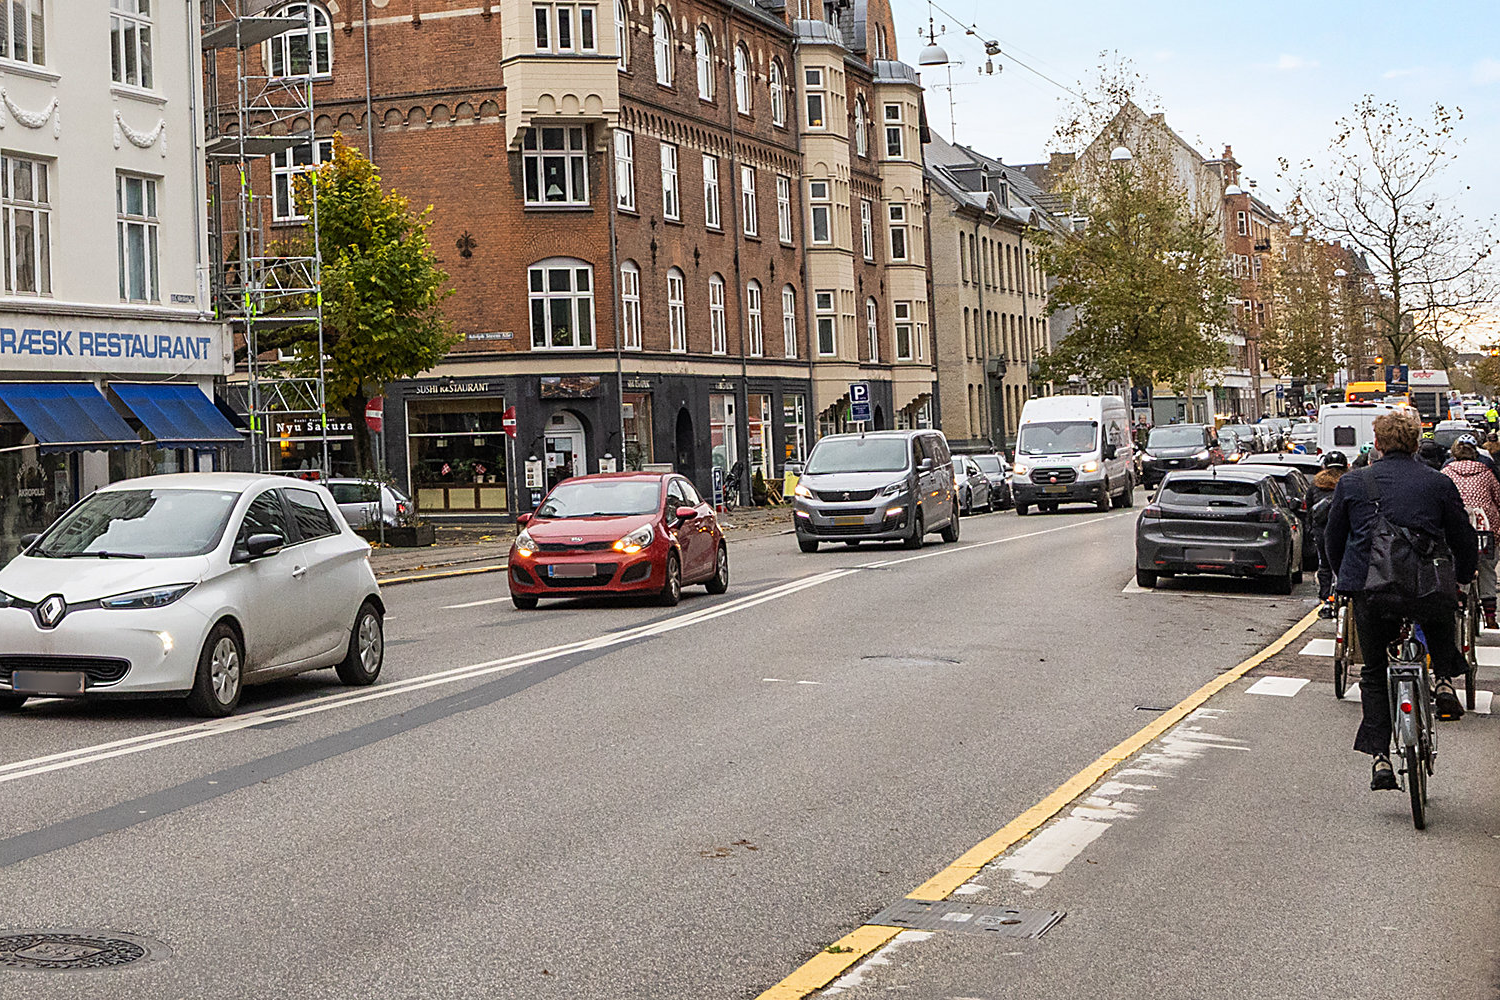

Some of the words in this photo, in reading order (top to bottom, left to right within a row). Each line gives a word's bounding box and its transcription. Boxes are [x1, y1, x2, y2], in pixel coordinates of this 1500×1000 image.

[79, 331, 211, 360] RESTAURANT
[416, 385, 438, 394] SUSHI
[854, 386, 865, 400] P
[276, 422, 302, 434] Nyu
[307, 422, 353, 431] Sakura
